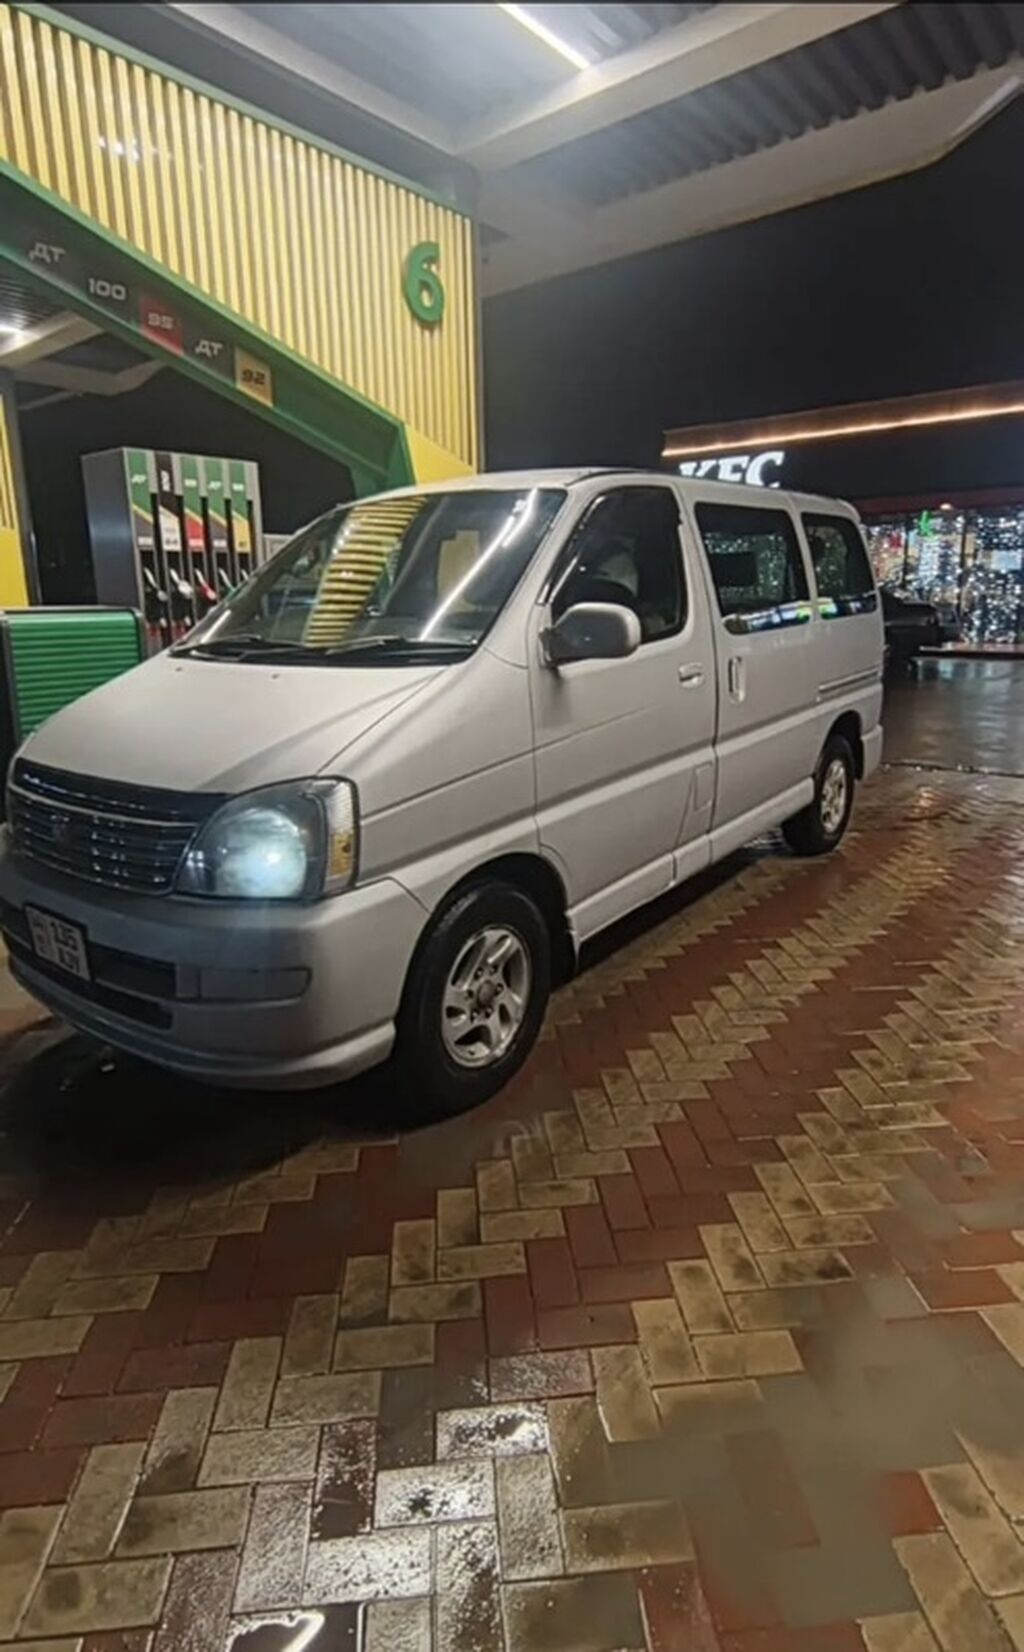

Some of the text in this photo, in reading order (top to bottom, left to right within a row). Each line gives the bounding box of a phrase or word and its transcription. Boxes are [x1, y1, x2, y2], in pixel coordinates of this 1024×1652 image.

[28, 242, 66, 263] ДТ
[88, 277, 127, 300] 100
[404, 241, 444, 324] 6
[148, 312, 175, 331] 95
[195, 339, 223, 358] ДТ
[241, 368, 266, 386] 92
